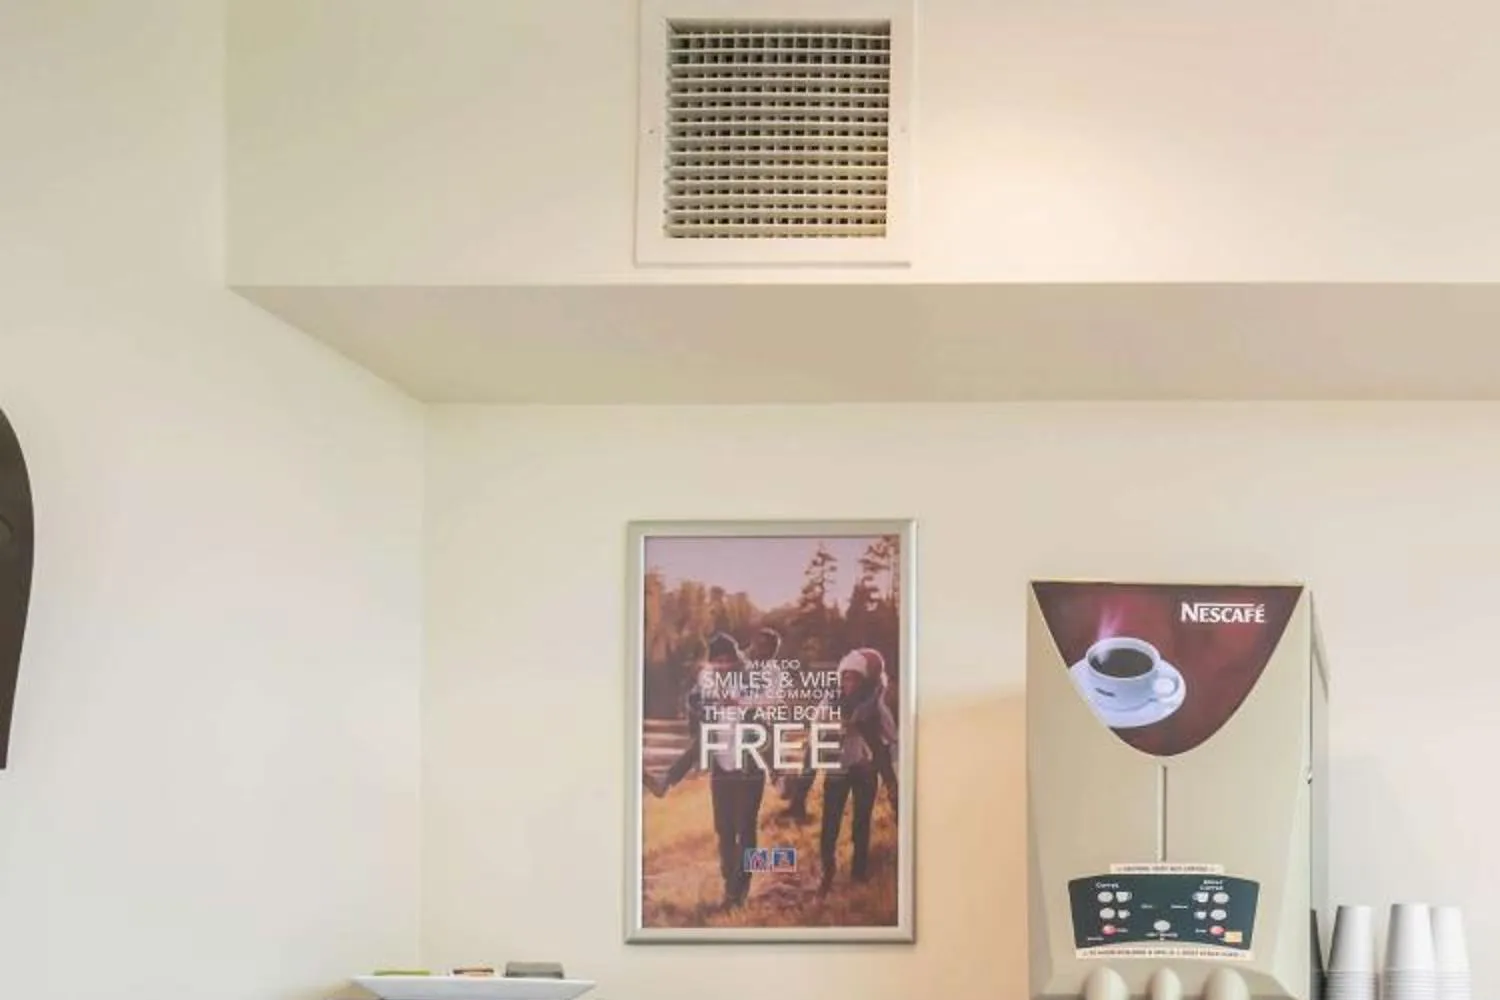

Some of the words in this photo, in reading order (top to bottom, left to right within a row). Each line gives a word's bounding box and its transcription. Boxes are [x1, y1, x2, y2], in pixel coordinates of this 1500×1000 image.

[1180, 602, 1266, 623] NESCAFÉ
[781, 659, 800, 669] DO
[702, 671, 773, 689] SMILES
[779, 671, 793, 689] &
[800, 671, 841, 689] WIFI
[703, 705, 747, 721] THEY
[753, 705, 788, 721] ARE
[794, 705, 842, 721] BOTH
[700, 722, 842, 770] FREE
